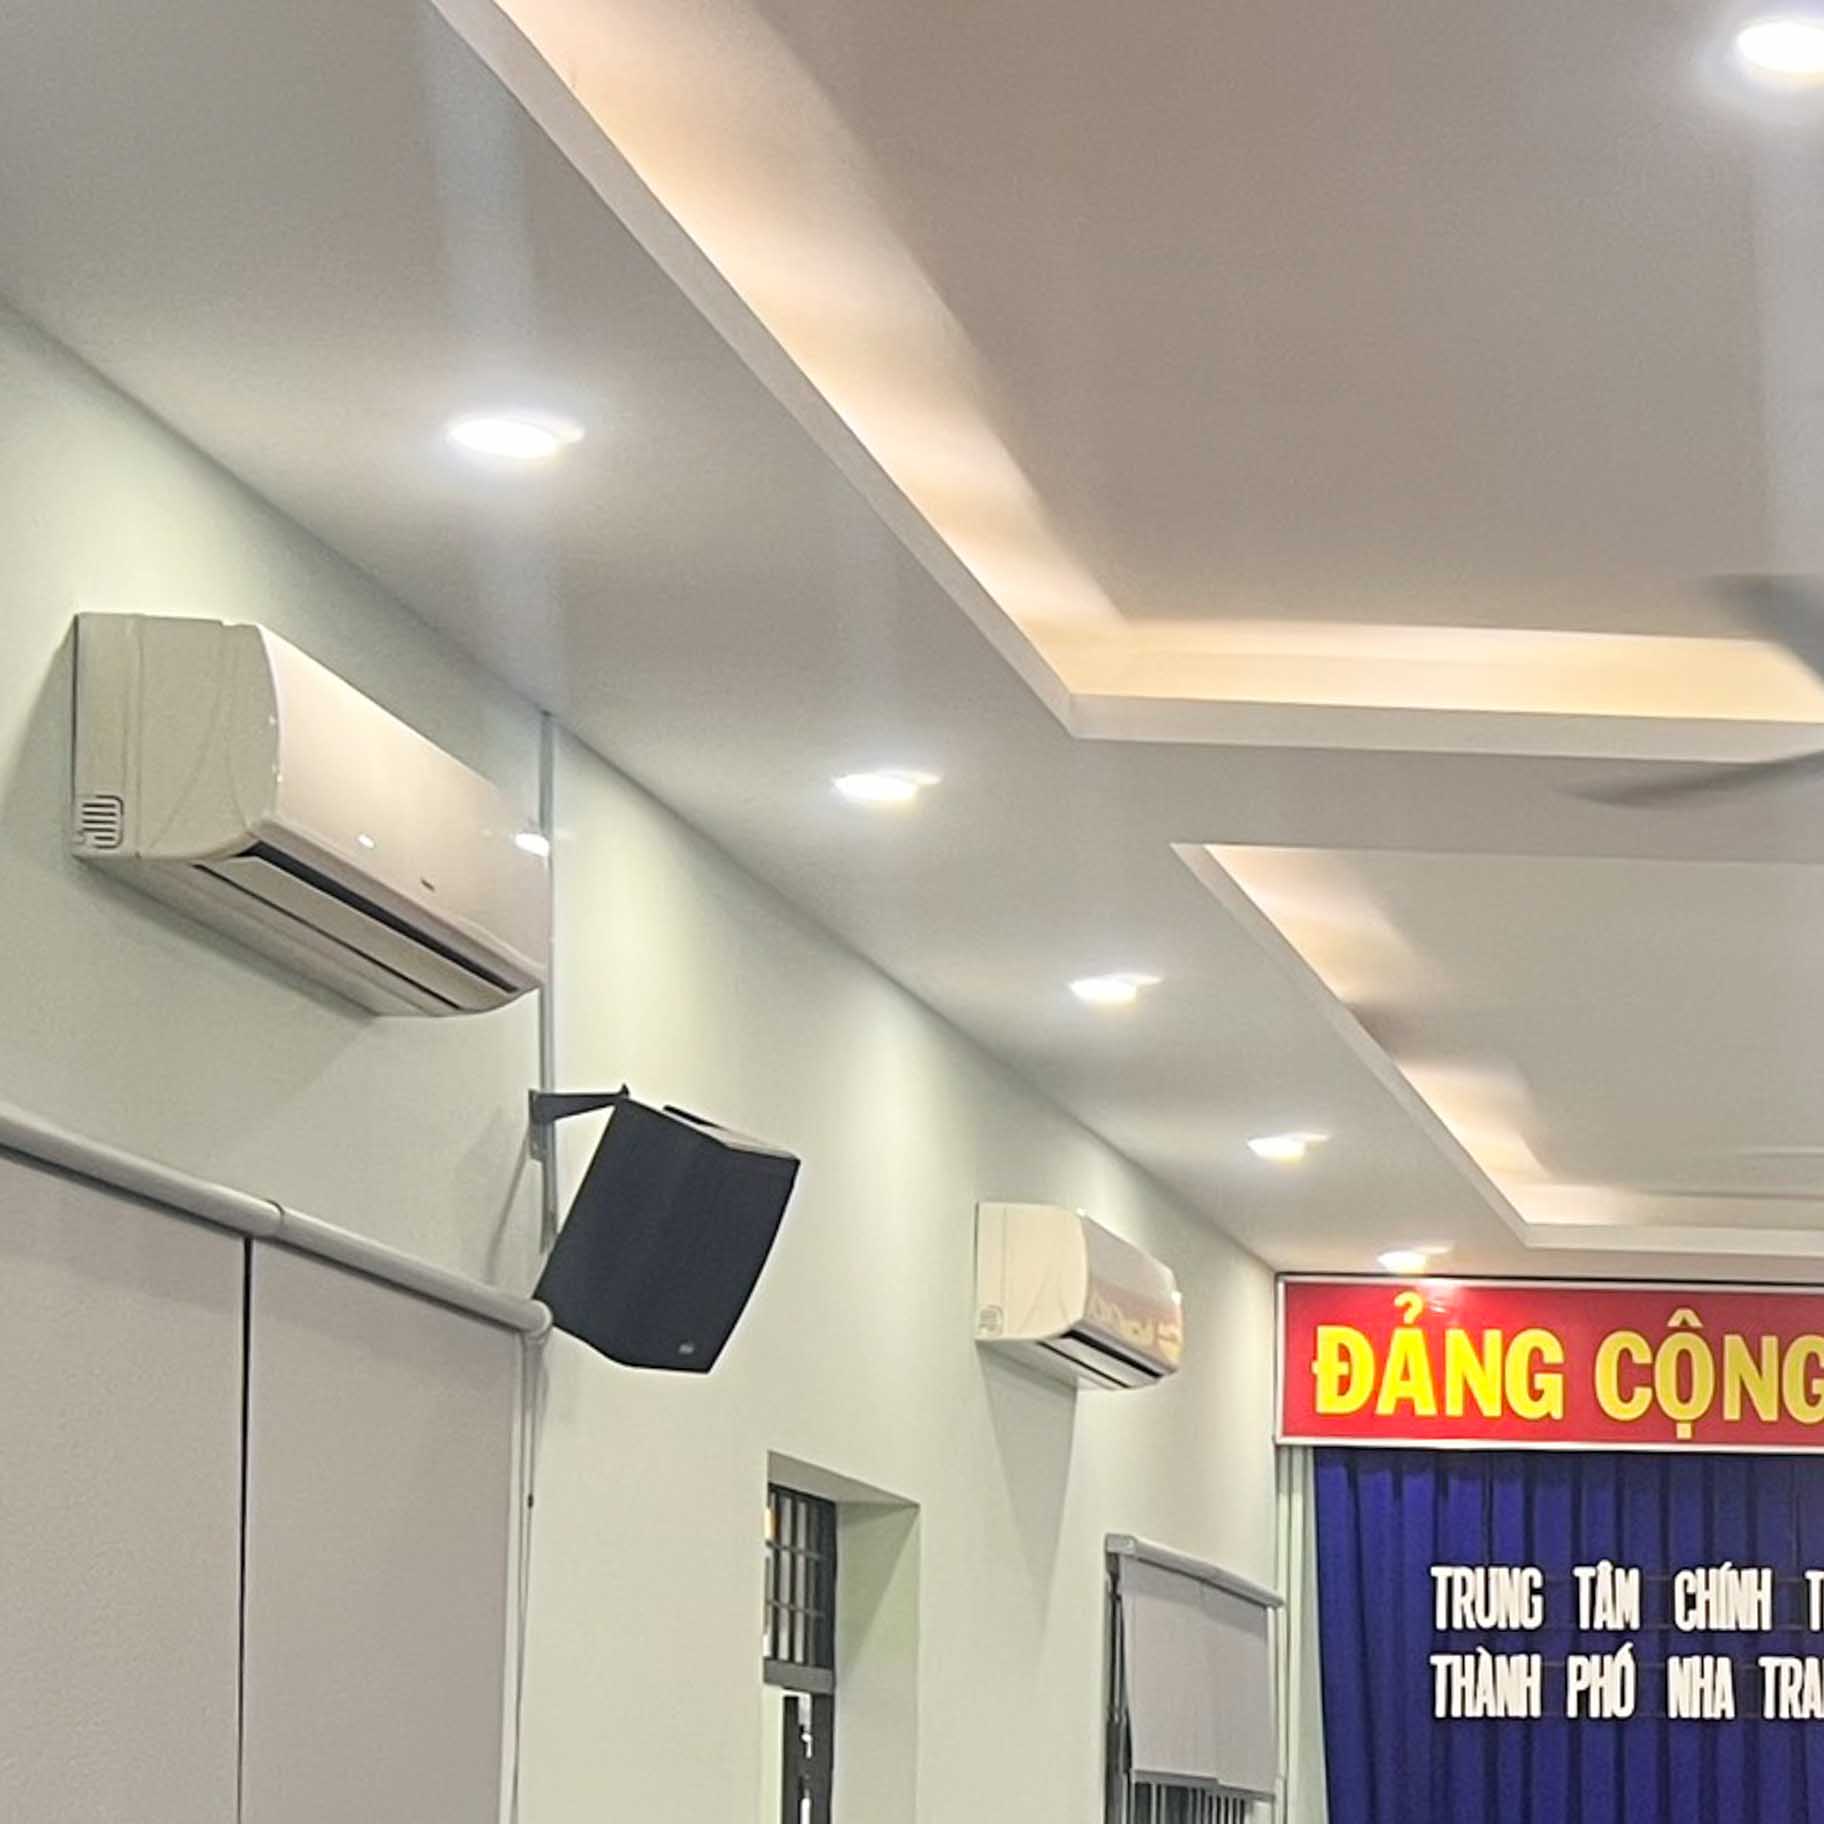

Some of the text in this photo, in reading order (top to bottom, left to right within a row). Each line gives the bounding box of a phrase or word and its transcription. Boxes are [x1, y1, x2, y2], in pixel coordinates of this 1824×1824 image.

[1311, 1292, 1566, 1420] ĐẢNG
[1429, 1565, 1544, 1631] TRUNG
[1572, 1560, 1641, 1631] TÂM
[1673, 1561, 1773, 1633] CHÍNH
[1428, 1646, 1543, 1719] THÀNH
[1667, 1654, 1736, 1720] NHA
